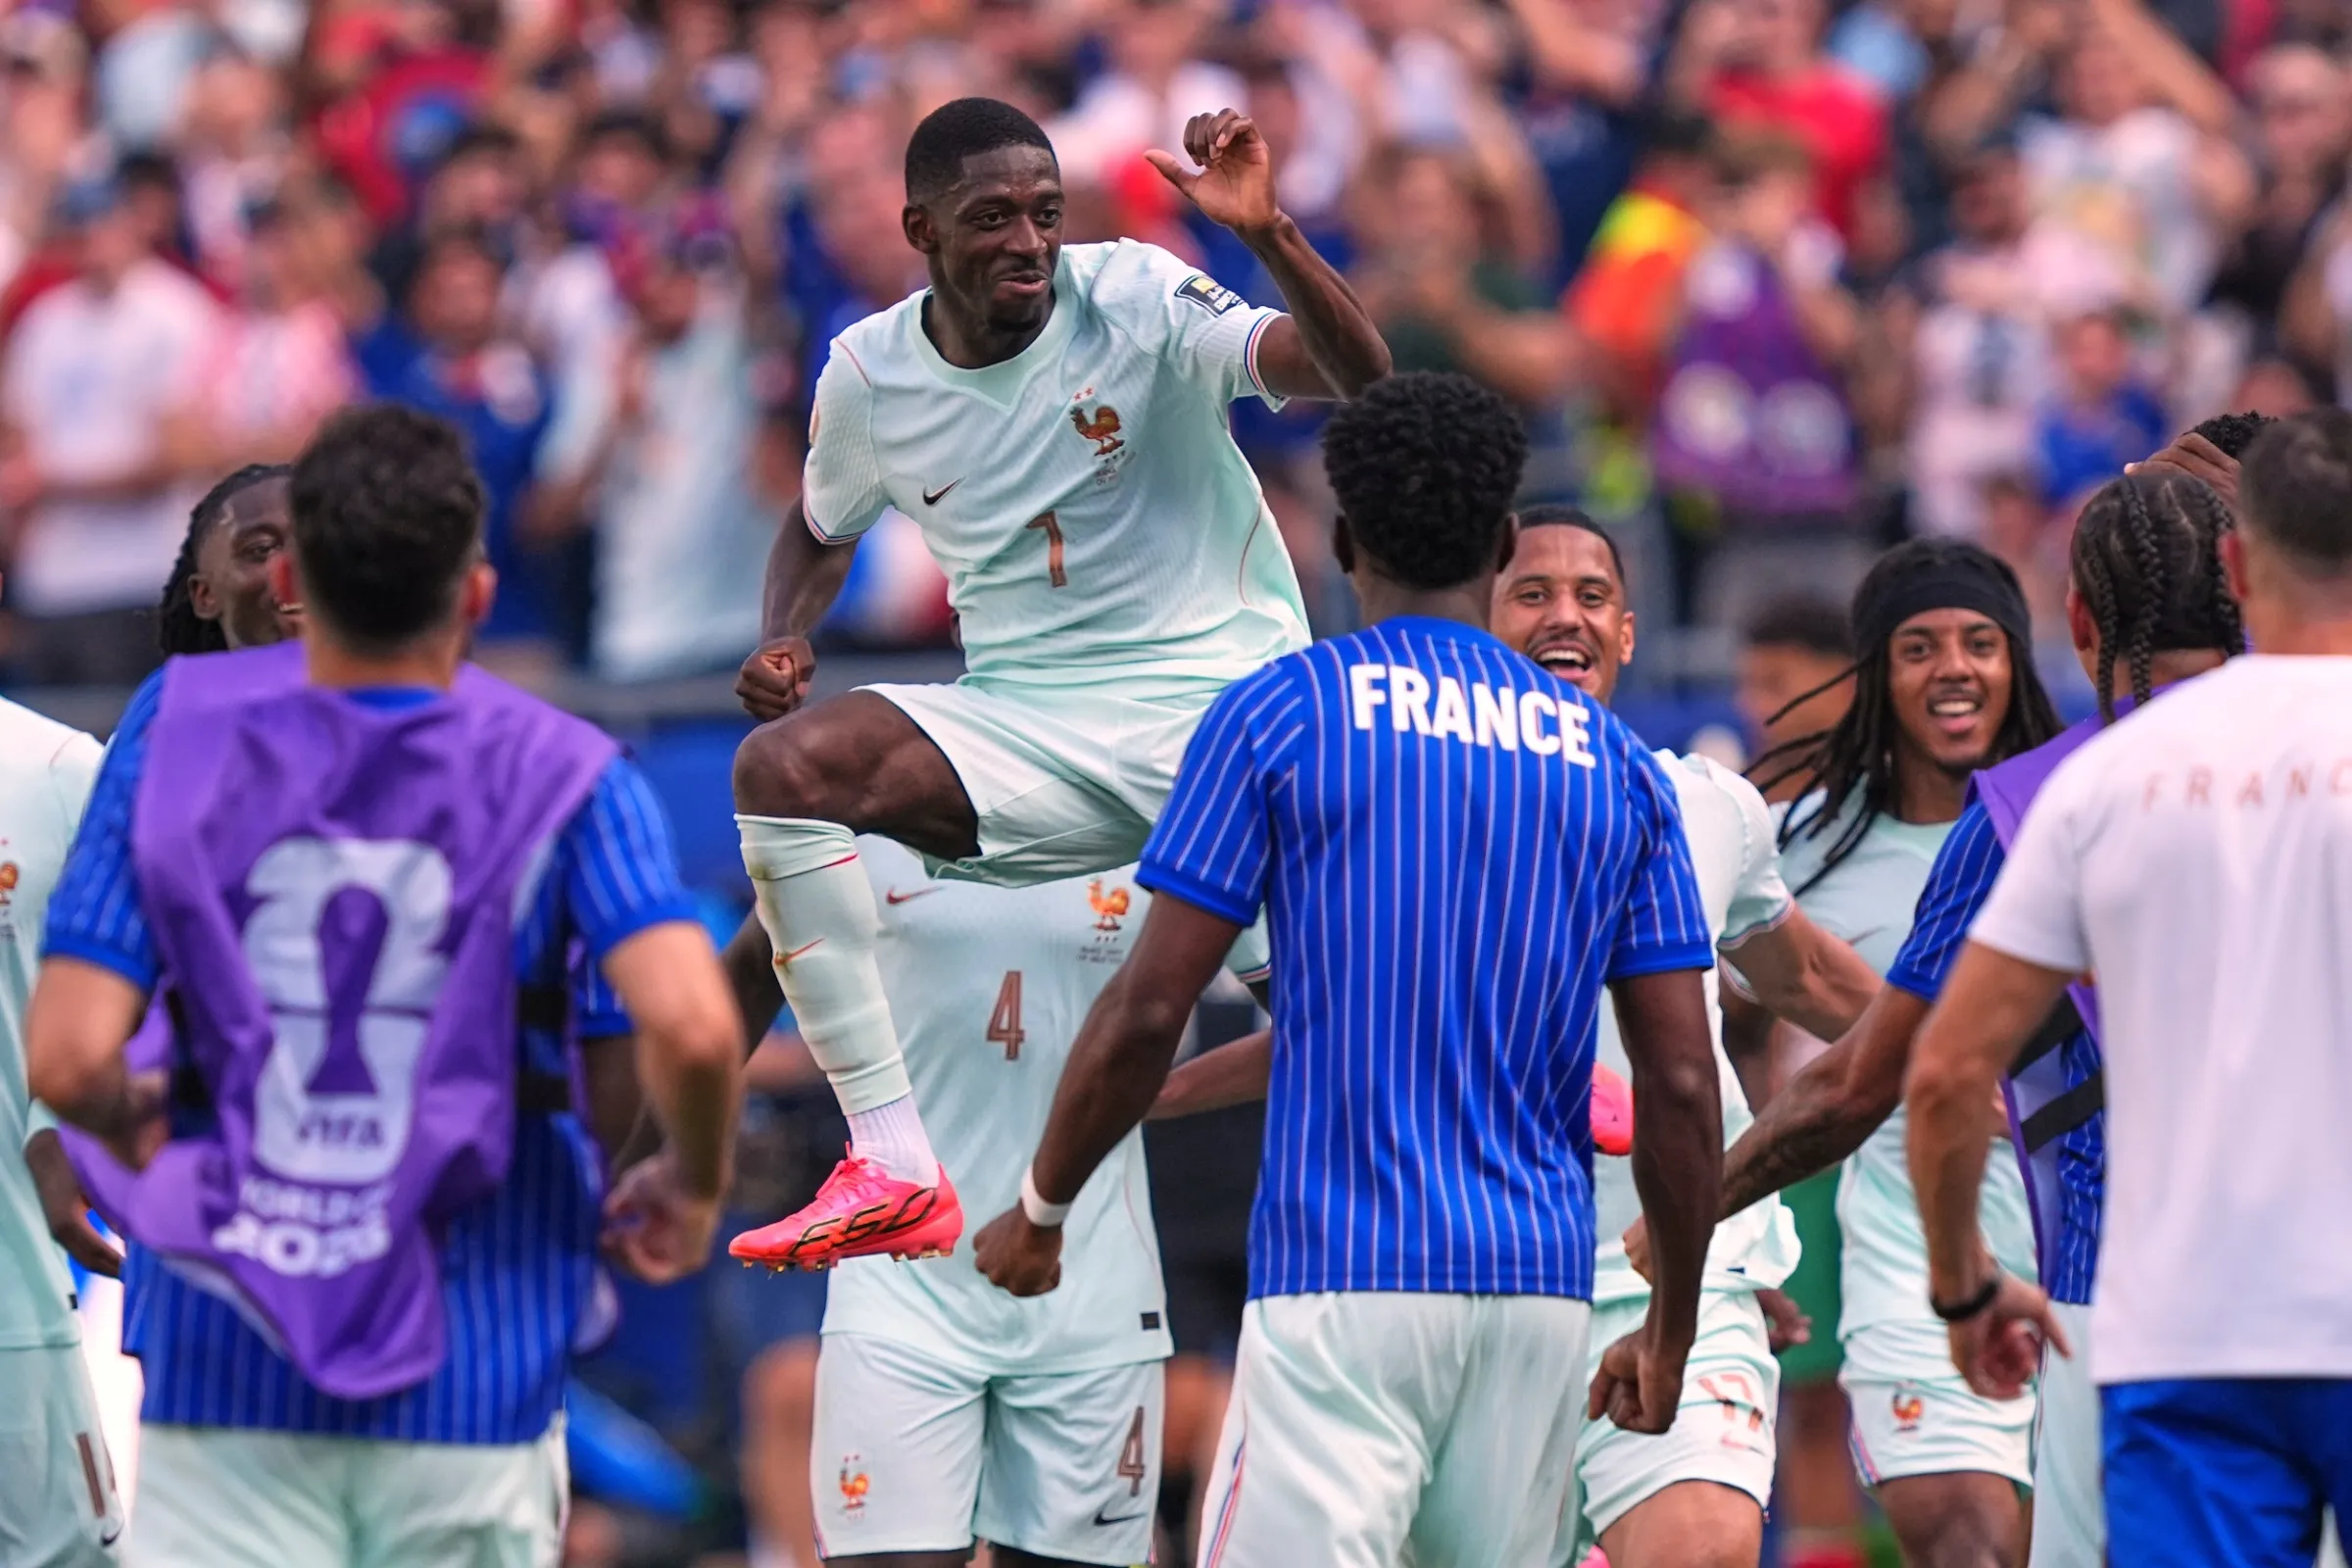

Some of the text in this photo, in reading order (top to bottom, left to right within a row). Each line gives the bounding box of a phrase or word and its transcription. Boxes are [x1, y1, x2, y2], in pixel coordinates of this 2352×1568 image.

[1025, 510, 1067, 588] 7
[1349, 663, 1596, 768] FRANCE
[986, 970, 1025, 1061] 4
[1116, 1405, 1145, 1497] 4
